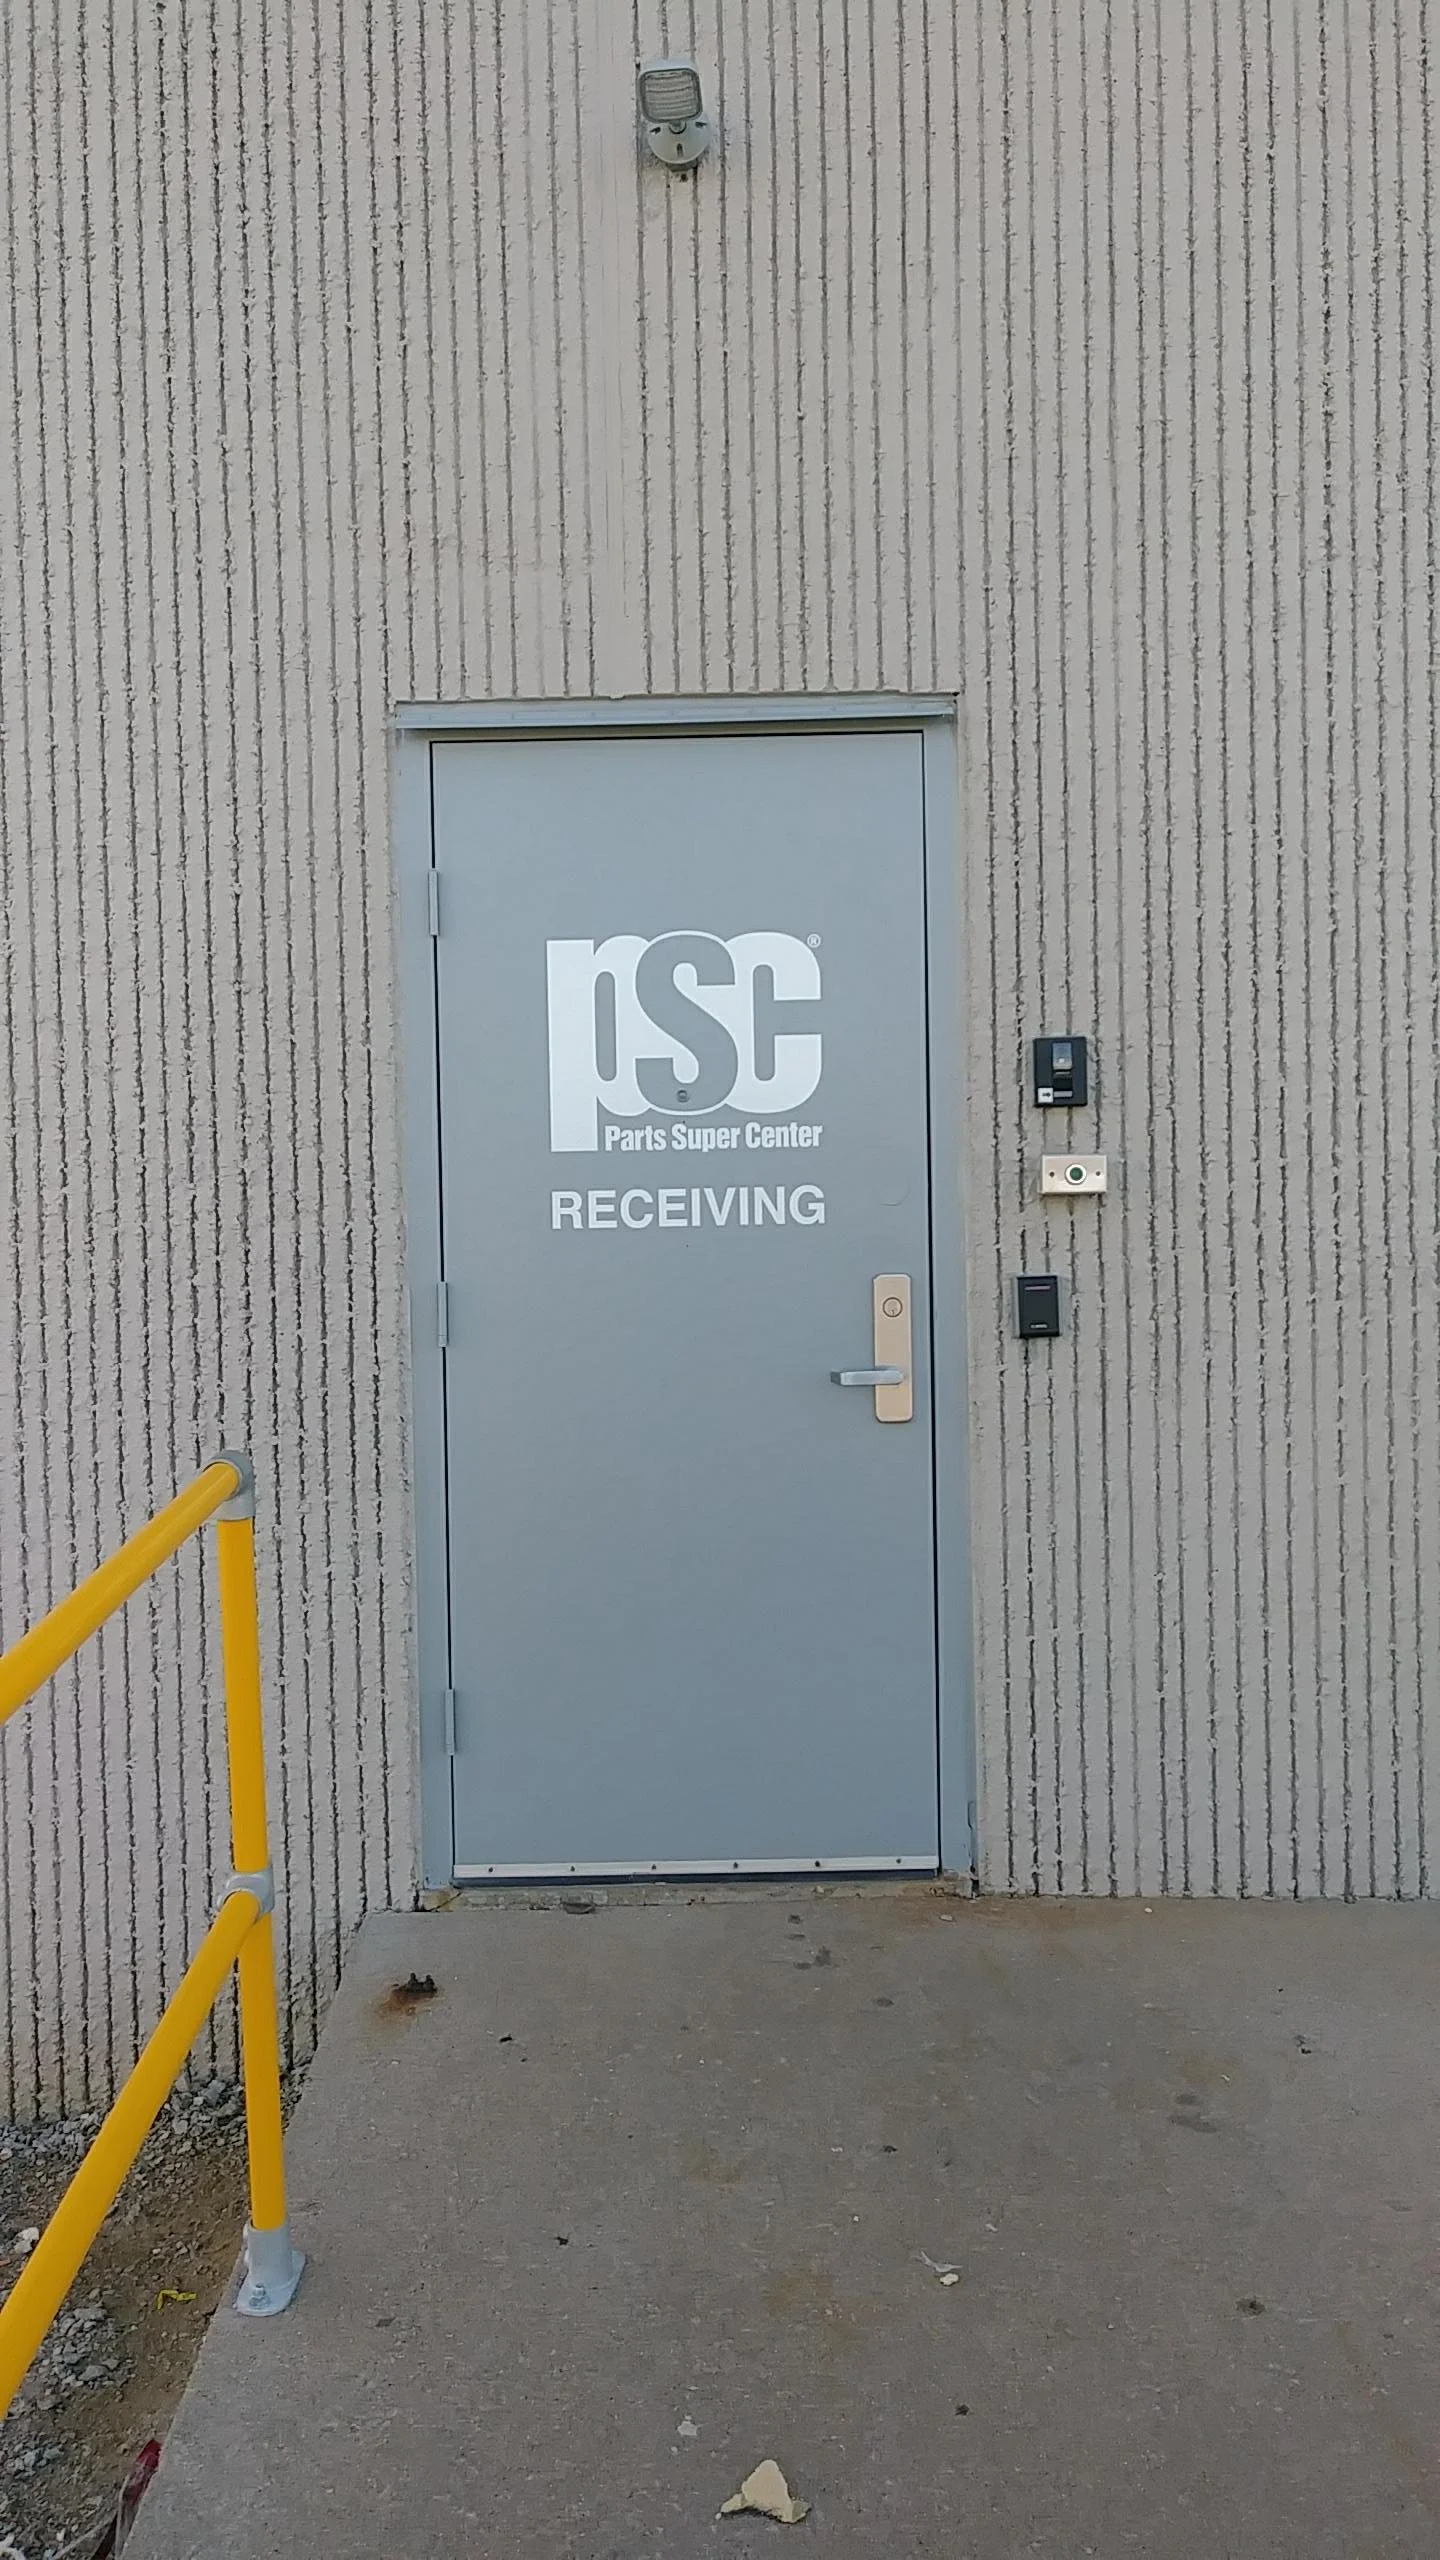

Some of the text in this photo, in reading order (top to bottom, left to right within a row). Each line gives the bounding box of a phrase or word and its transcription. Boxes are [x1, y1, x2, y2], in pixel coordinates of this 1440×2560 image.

[604, 1121, 823, 1152] Parts Super Center
[550, 1184, 826, 1230] RECEIVING
